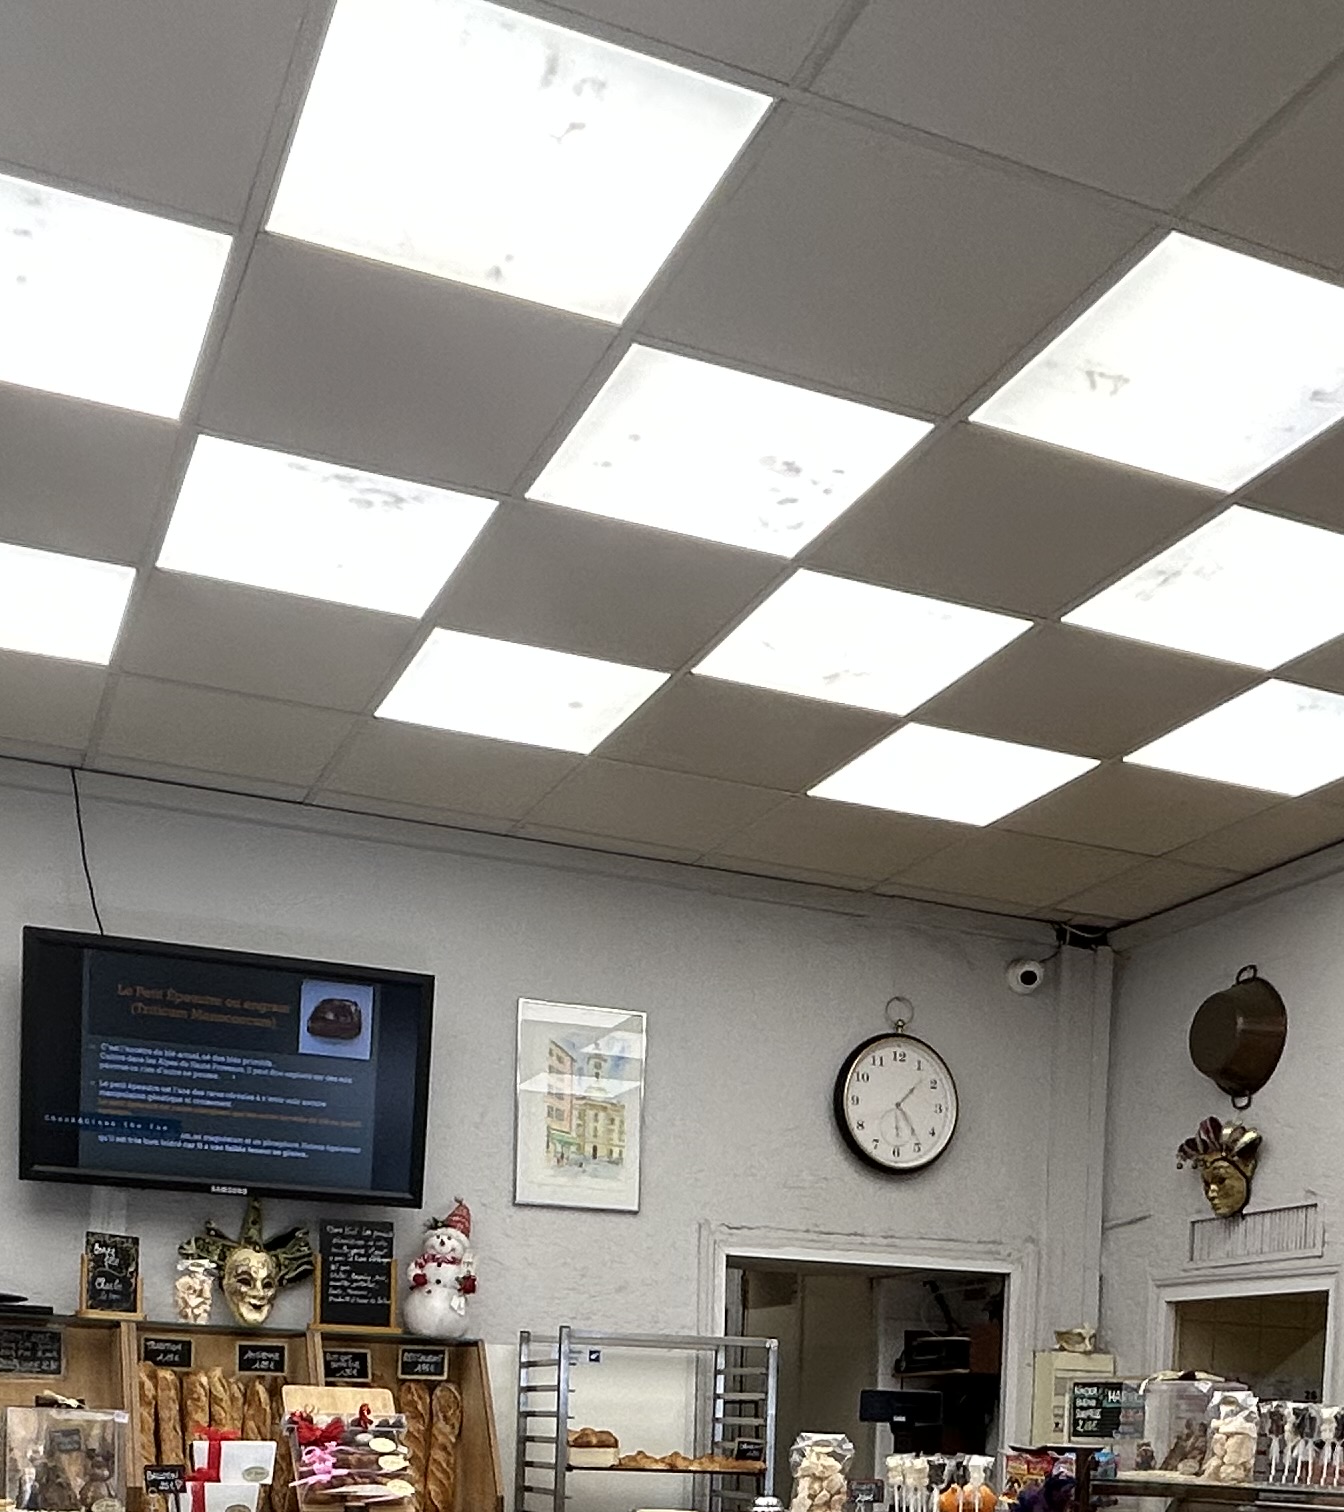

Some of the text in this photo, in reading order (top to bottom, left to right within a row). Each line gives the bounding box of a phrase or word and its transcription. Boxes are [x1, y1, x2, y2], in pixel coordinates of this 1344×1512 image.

[871, 1055, 884, 1067] 11
[893, 1050, 907, 1063] 12
[916, 1060, 922, 1072] 1
[855, 1071, 870, 1083] 10
[930, 1079, 938, 1090] 2
[851, 1095, 860, 1106] 9
[935, 1103, 943, 1114] 3
[856, 1120, 865, 1131] 8
[928, 1127, 936, 1137] 4
[872, 1138, 880, 1150] 7
[913, 1142, 922, 1153] 5
[892, 1147, 901, 1158] 6
